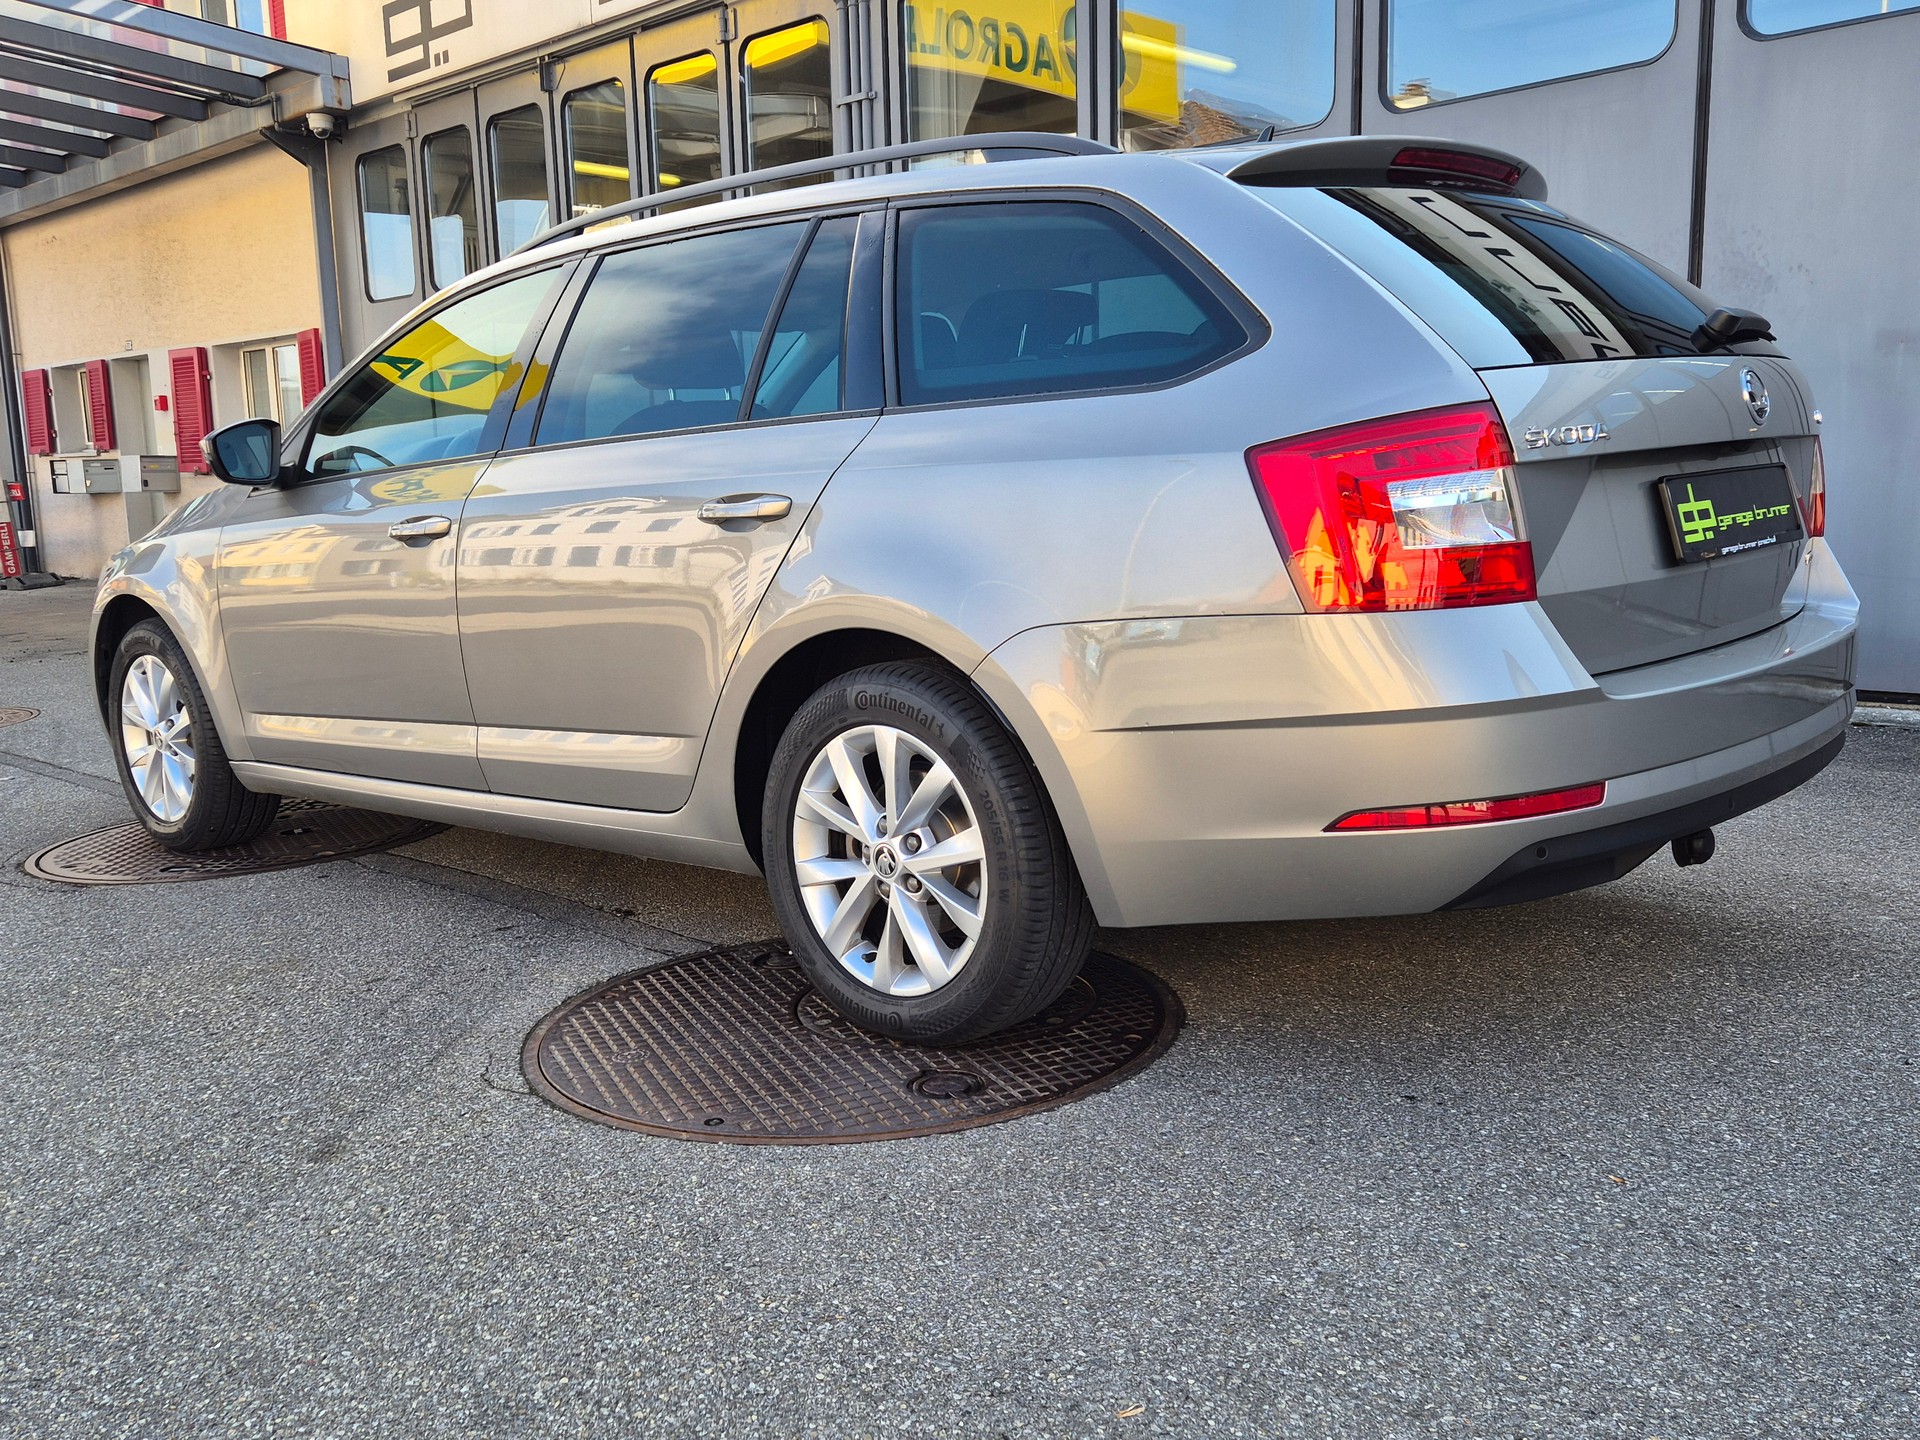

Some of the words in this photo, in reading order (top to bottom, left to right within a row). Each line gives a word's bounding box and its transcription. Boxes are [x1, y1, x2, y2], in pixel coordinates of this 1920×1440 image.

[1525, 423, 1611, 450] ŠKODA
[1717, 511, 1754, 531] garage
[854, 690, 936, 731] Continental
[978, 789, 1004, 846] 205/55
